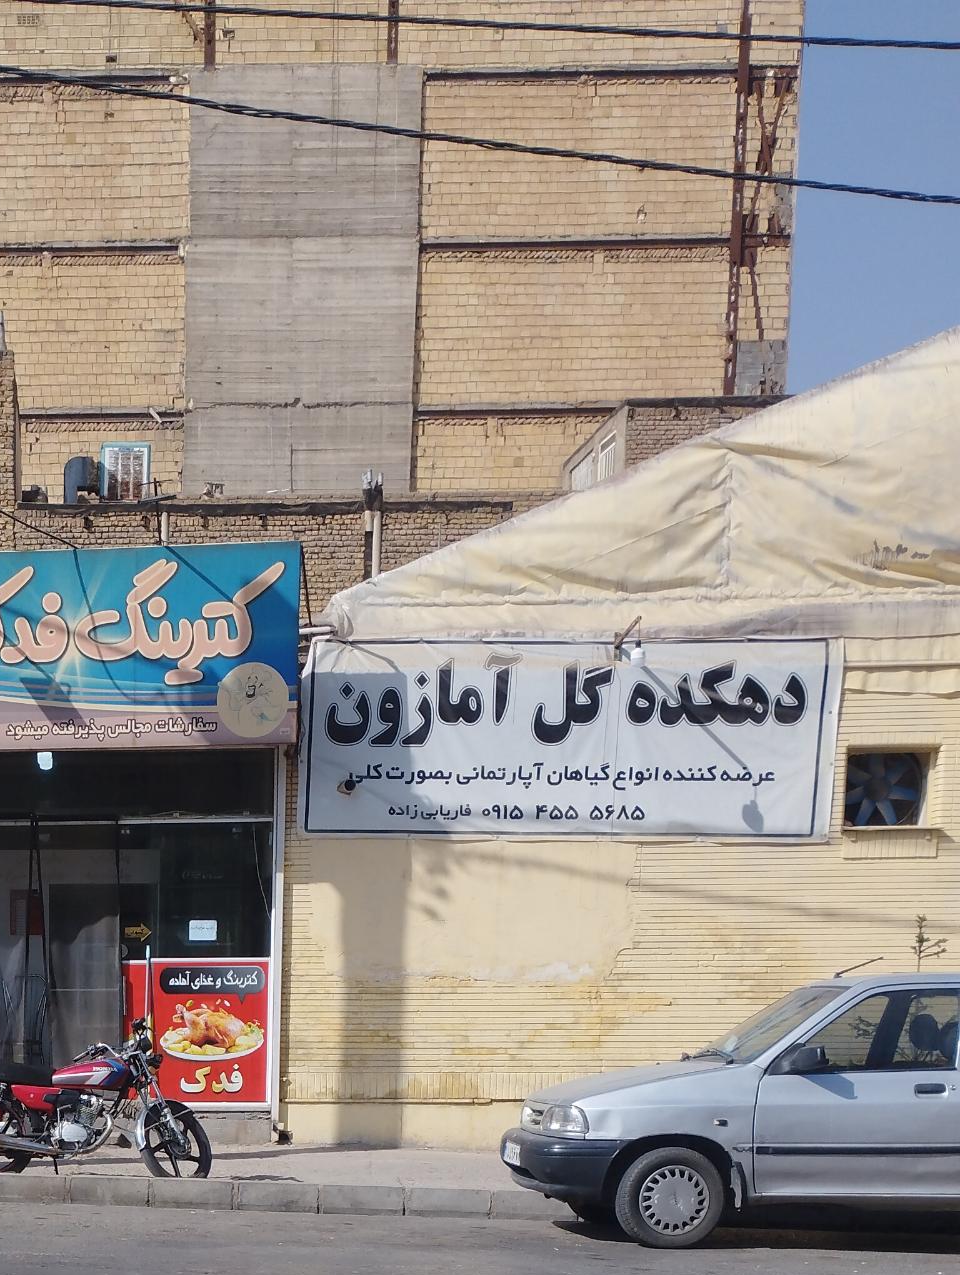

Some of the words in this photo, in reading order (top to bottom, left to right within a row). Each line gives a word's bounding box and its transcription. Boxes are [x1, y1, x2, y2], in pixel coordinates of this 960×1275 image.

[74, 559, 285, 686] کترینگ
[324, 653, 523, 747] آمازون
[531, 658, 615, 746] گل
[625, 659, 808, 727] دهکده
[6, 720, 49, 741] میشود
[51, 718, 105, 742] پذیرفته
[108, 718, 151, 738] مجالس
[155, 716, 218, 736] سفارشات
[348, 763, 383, 784] کلی
[385, 766, 452, 786] بصورت
[456, 762, 544, 789] آپارتمانی
[547, 762, 610, 786] گیاهان
[613, 767, 659, 791] انواع
[663, 765, 717, 782] کننده
[720, 766, 776, 787] عرضه
[388, 804, 418, 821] زاده
[421, 803, 472, 821] فاریابی
[482, 804, 524, 821] ۰۹۱۵
[535, 804, 579, 821] ۴۵۵
[589, 804, 646, 821] ۵۶۸۵
[169, 970, 191, 986] آماده
[191, 972, 215, 990] غذای
[215, 977, 222, 989] و
[223, 970, 258, 988] کترینگ
[180, 1063, 244, 1093] فدک
